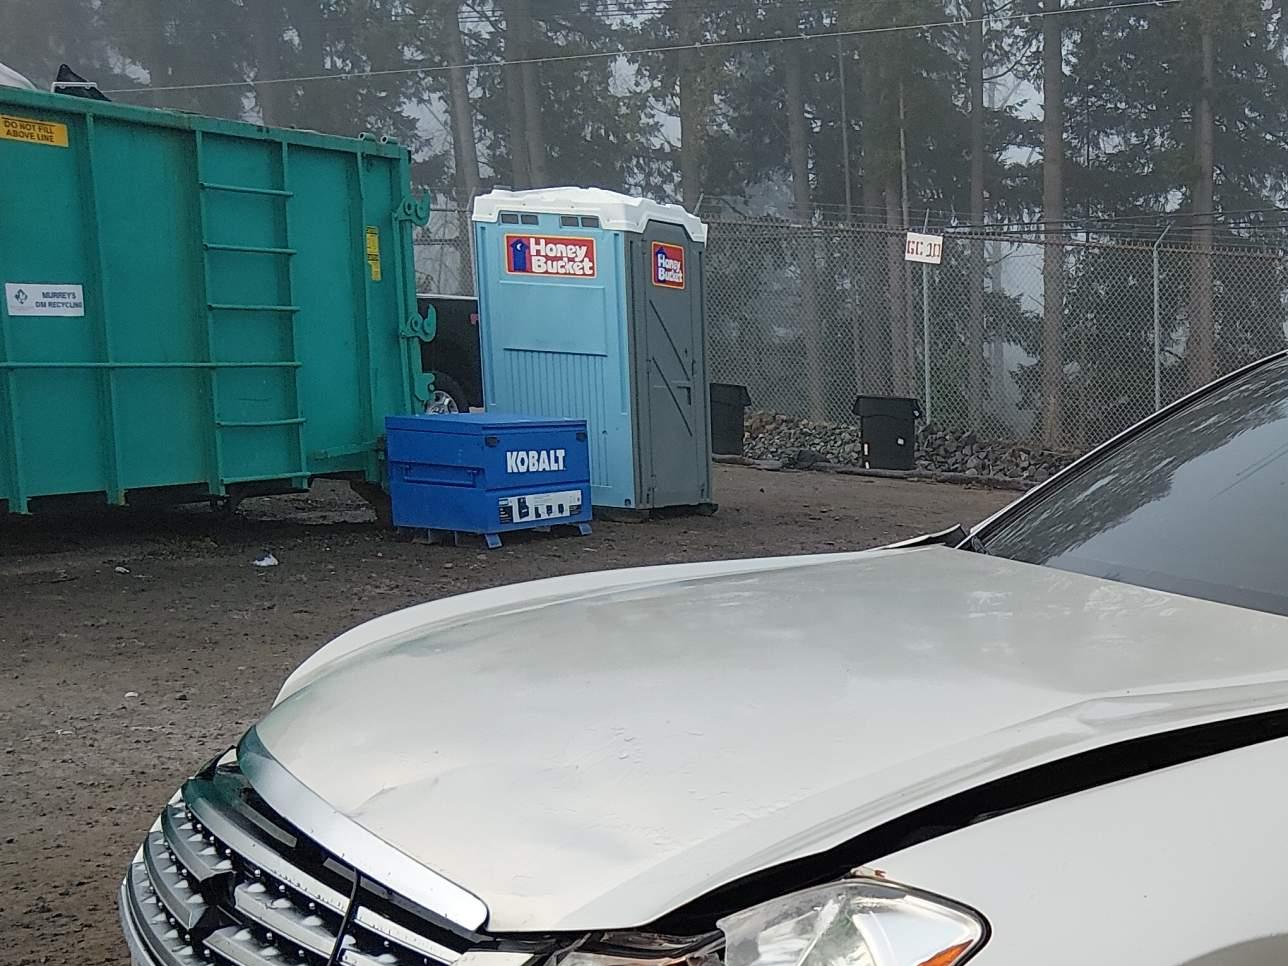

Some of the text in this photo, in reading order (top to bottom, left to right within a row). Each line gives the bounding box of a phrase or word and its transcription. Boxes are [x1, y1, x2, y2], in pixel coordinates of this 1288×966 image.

[4, 120, 54, 134] DO NOT FILL
[6, 129, 55, 143] ABOVE LINE
[530, 238, 587, 260] Honey
[531, 256, 594, 275] Bucket
[657, 253, 682, 271] Honey
[657, 267, 684, 282] Bucket
[506, 449, 566, 473] KOBALT
